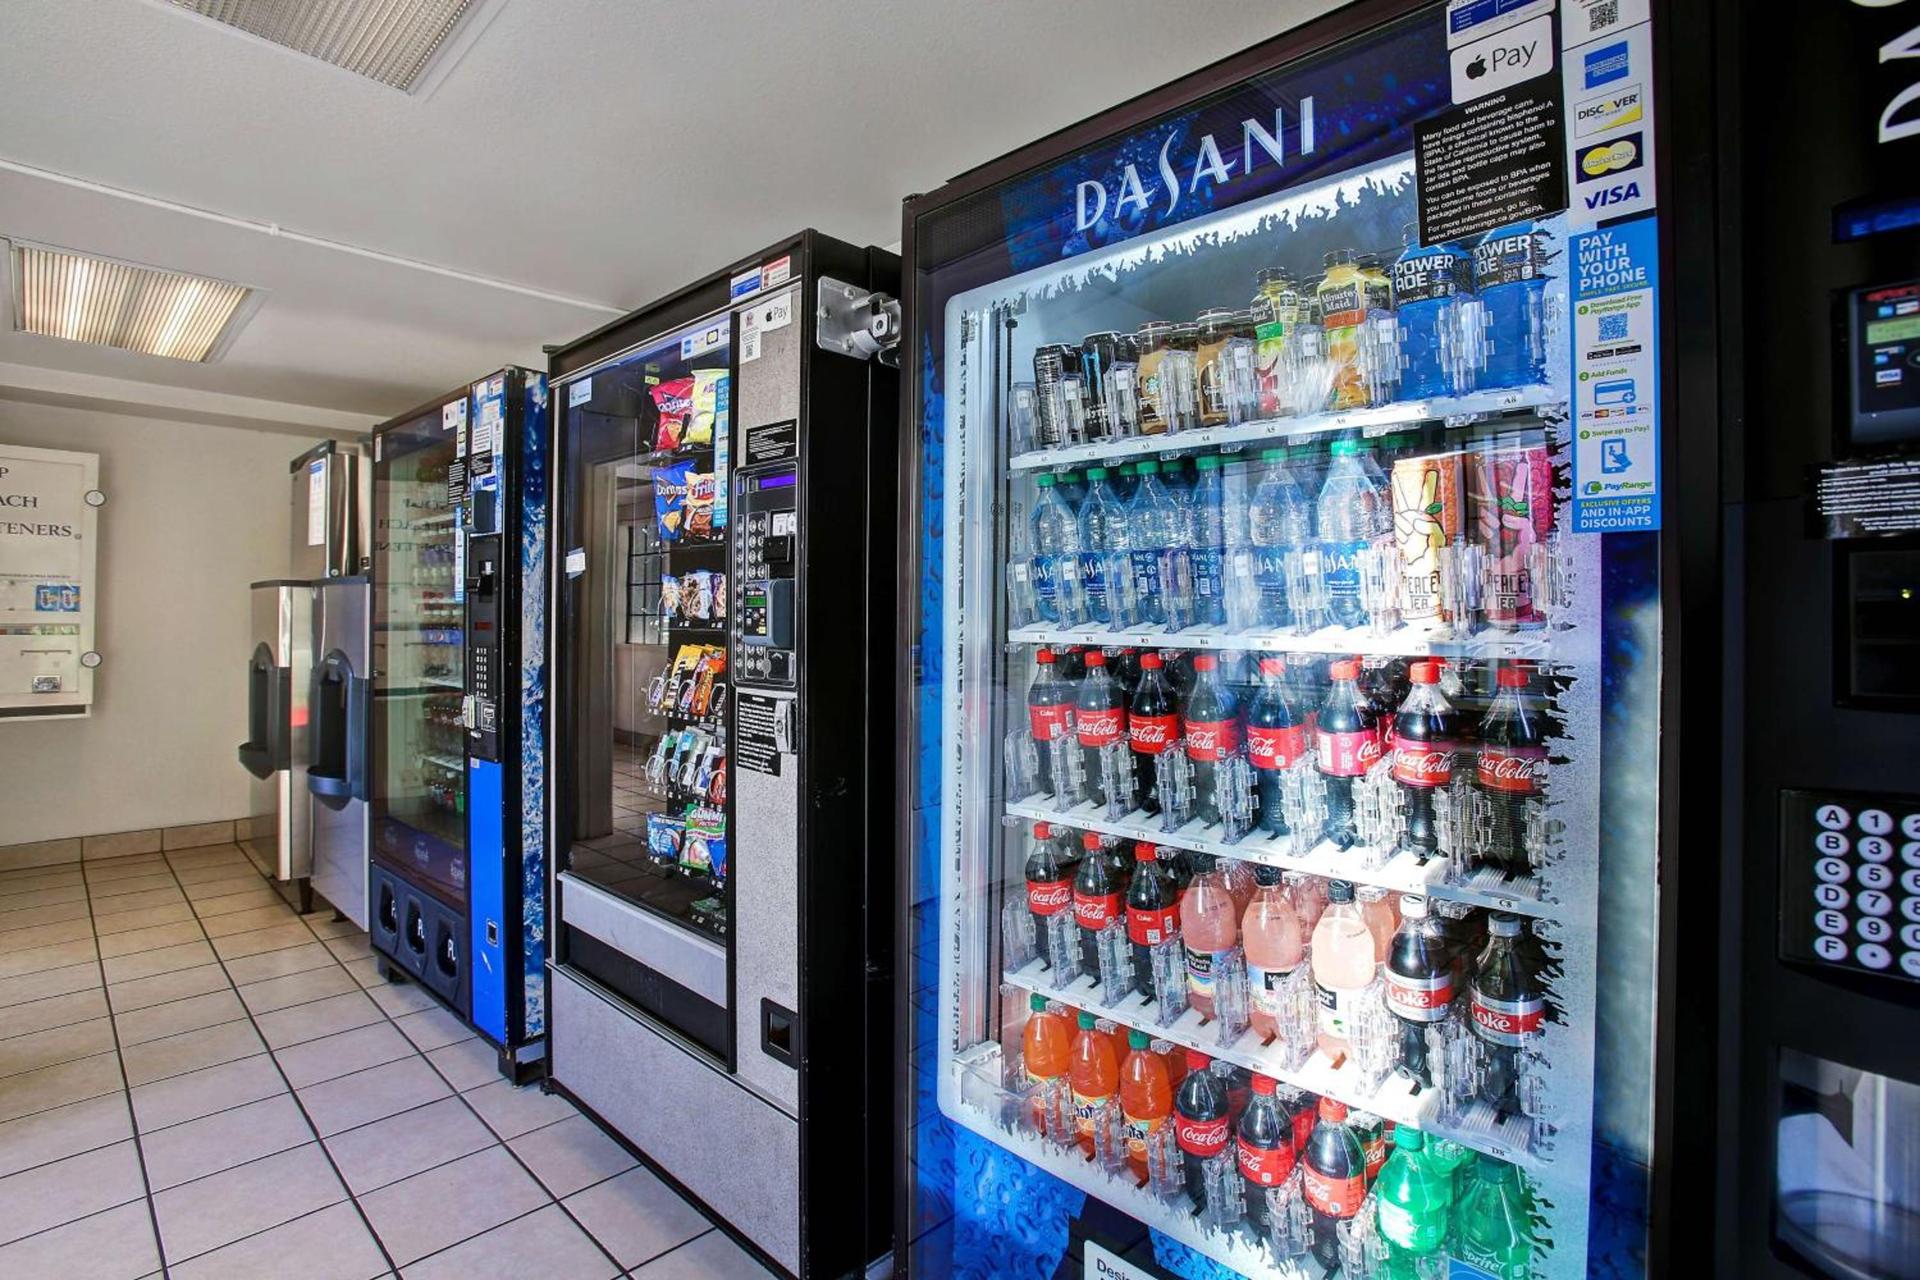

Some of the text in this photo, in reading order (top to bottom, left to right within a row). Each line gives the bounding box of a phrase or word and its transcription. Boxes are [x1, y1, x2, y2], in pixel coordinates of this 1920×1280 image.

[1492, 40, 1537, 72] Pay
[1464, 95, 1505, 113] WARNING
[1422, 99, 1533, 141] Many food and beverage cans
[1422, 138, 1440, 149] have
[1466, 116, 1505, 134] containing
[1546, 100, 1553, 109] A
[1423, 156, 1442, 165] State
[1452, 141, 1487, 156] California
[1489, 138, 1496, 146] to
[1498, 130, 1522, 142] cause
[1524, 122, 1544, 134] harm
[1546, 119, 1554, 127] to
[1453, 132, 1487, 147] chemical
[1489, 123, 1513, 136] known
[1515, 120, 1523, 128] to
[1525, 116, 1537, 125] the
[1076, 96, 1315, 231] DASANI
[1424, 166, 1435, 175] the
[1462, 143, 1509, 162] reproductive
[1424, 175, 1435, 184] Jar
[1451, 166, 1465, 175] and
[1467, 159, 1487, 170] bottle
[1489, 153, 1508, 163] caps
[1509, 147, 1527, 156] may
[1528, 141, 1545, 151] also
[1425, 179, 1450, 191] contain
[1426, 195, 1439, 204] You
[1440, 190, 1454, 199] can
[1456, 187, 1465, 195] be
[1466, 177, 1499, 191] exposed
[1510, 169, 1527, 178] BPA
[1528, 162, 1550, 172] when
[1426, 172, 1549, 213] you consume foods or beverages
[1585, 182, 1641, 209] VISA
[1426, 207, 1461, 221] packaged
[1471, 198, 1492, 208] these
[1428, 225, 1439, 233] For
[1440, 220, 1459, 229] more
[1507, 203, 1517, 211] go
[1579, 232, 1612, 251] PAY
[1579, 242, 1628, 265] WITH
[1395, 255, 1454, 278] POWER
[1579, 256, 1631, 278] YOUR
[1396, 272, 1428, 292] ADE
[1580, 267, 1646, 291] PHONE
[1326, 300, 1351, 312] Maid
[657, 484, 687, 496] Doritos
[1604, 481, 1652, 491] PayRange
[1581, 505, 1651, 518] AND IN-APP
[1581, 516, 1652, 528] DISCOUNTS
[1409, 598, 1429, 609] TEA
[1496, 597, 1516, 609] TEA
[1825, 810, 1841, 823] A
[1870, 814, 1880, 828] 1
[1825, 835, 1881, 855] B 3
[1824, 862, 1840, 876] C
[1868, 868, 1881, 882] 5
[1030, 887, 1071, 906] Coca-Cola
[1825, 888, 1840, 901] D
[1867, 894, 1881, 908] 7
[1825, 914, 1881, 935] E 9
[1825, 940, 1838, 953] F
[1182, 1125, 1229, 1146] Coca-Cola
